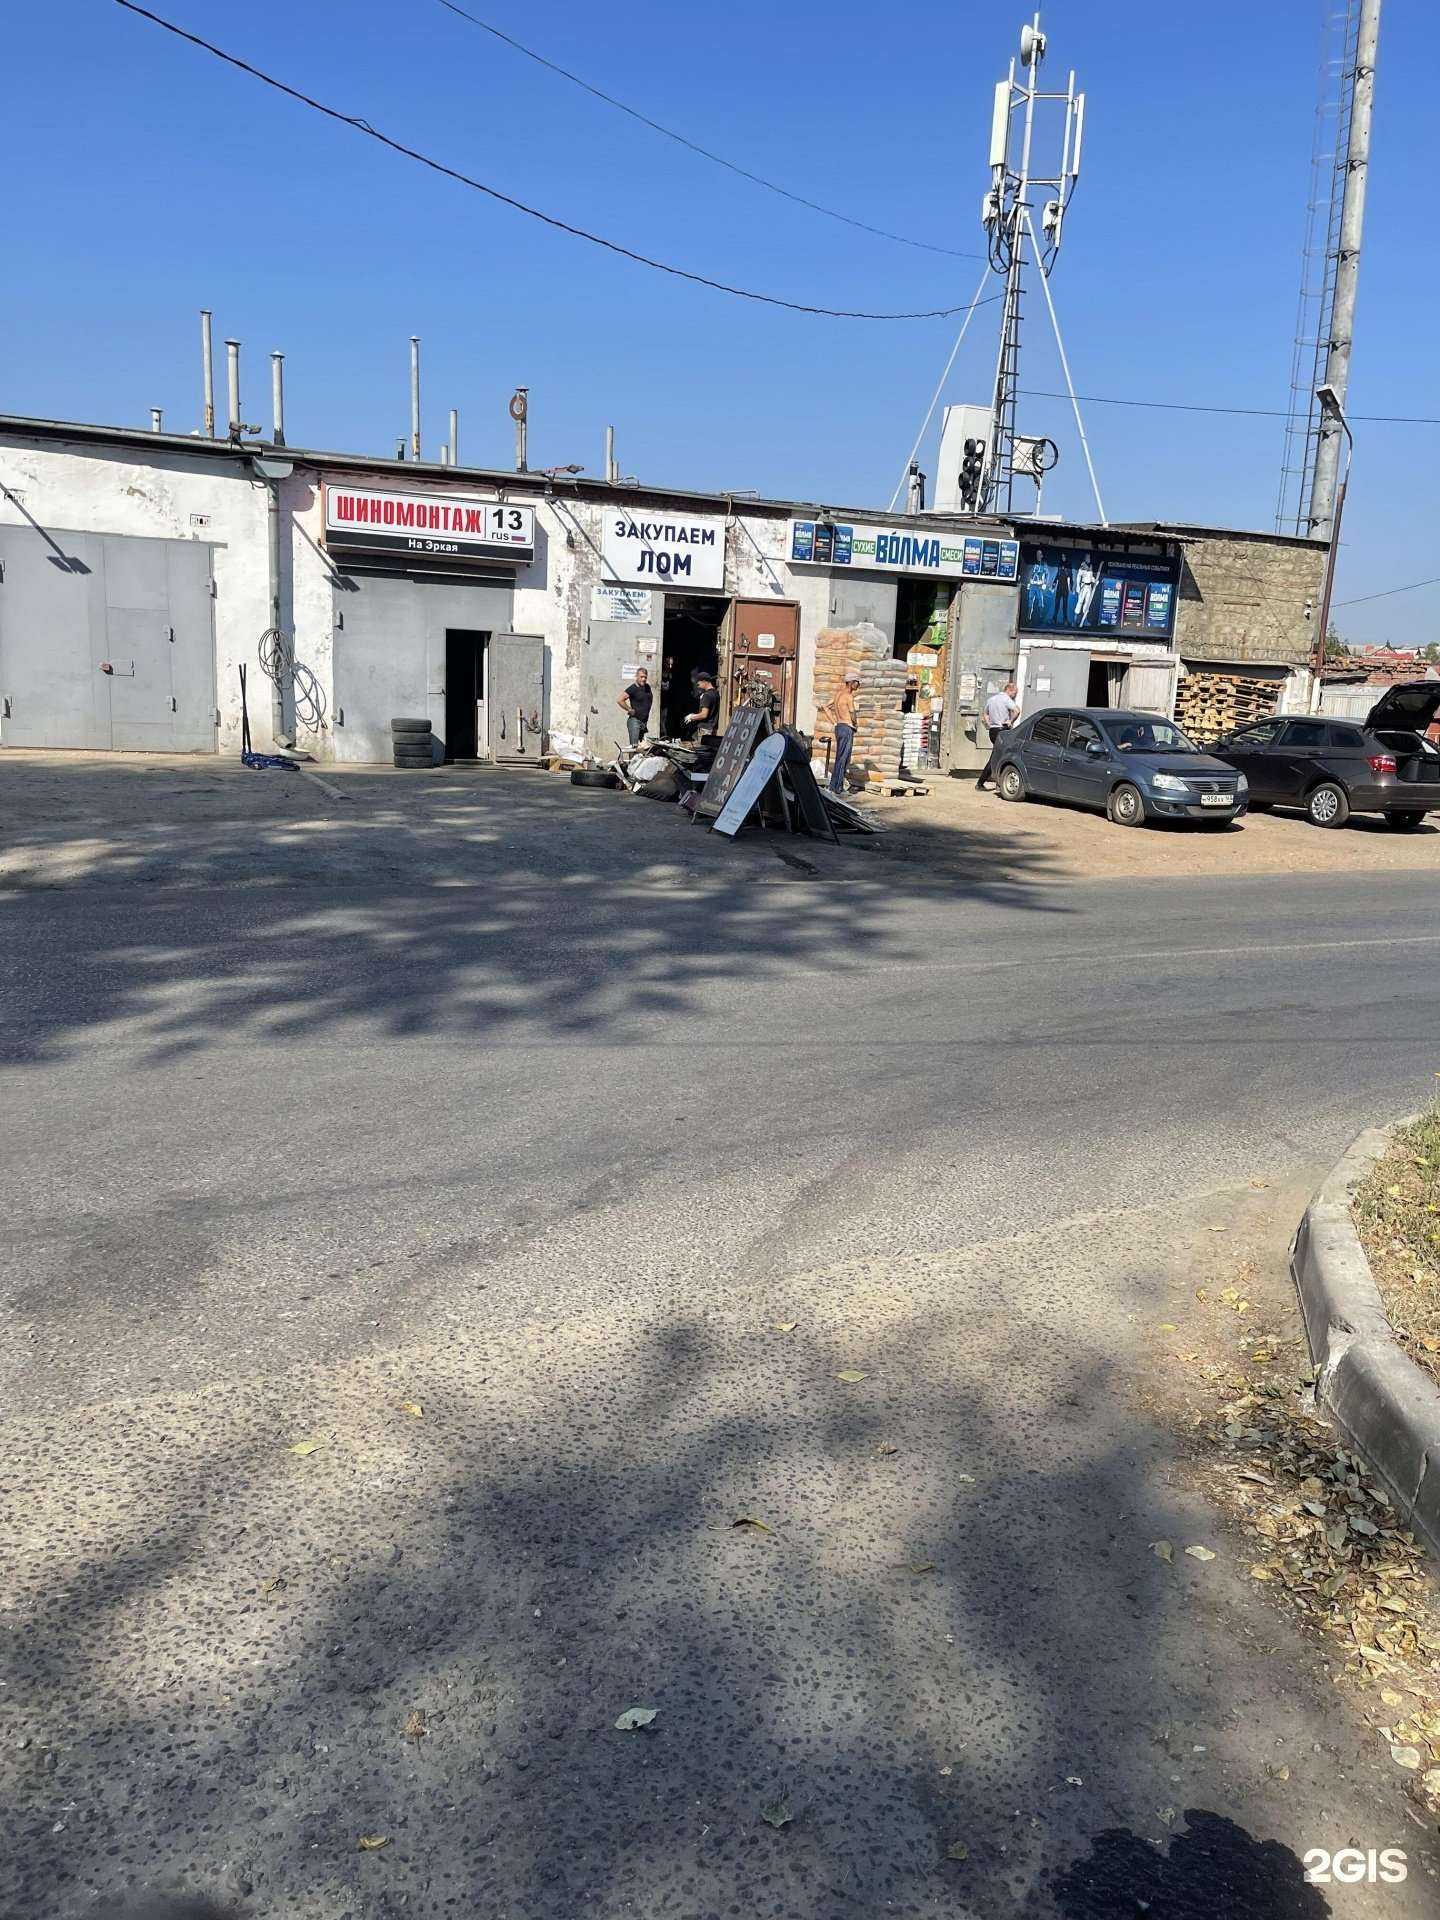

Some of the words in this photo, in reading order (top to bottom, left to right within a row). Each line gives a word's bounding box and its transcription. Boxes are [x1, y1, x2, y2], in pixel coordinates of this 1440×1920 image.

[337, 495, 482, 534] ШИНОМОНТАЖ
[492, 508, 523, 531] 13
[491, 531, 510, 541] rus
[615, 520, 715, 546] ЗАКУПАЕМ
[408, 538, 424, 550] На
[853, 541, 875, 553] СУХИЕ
[637, 550, 692, 576] ЛОМ
[941, 548, 963, 561] СМЕСИ
